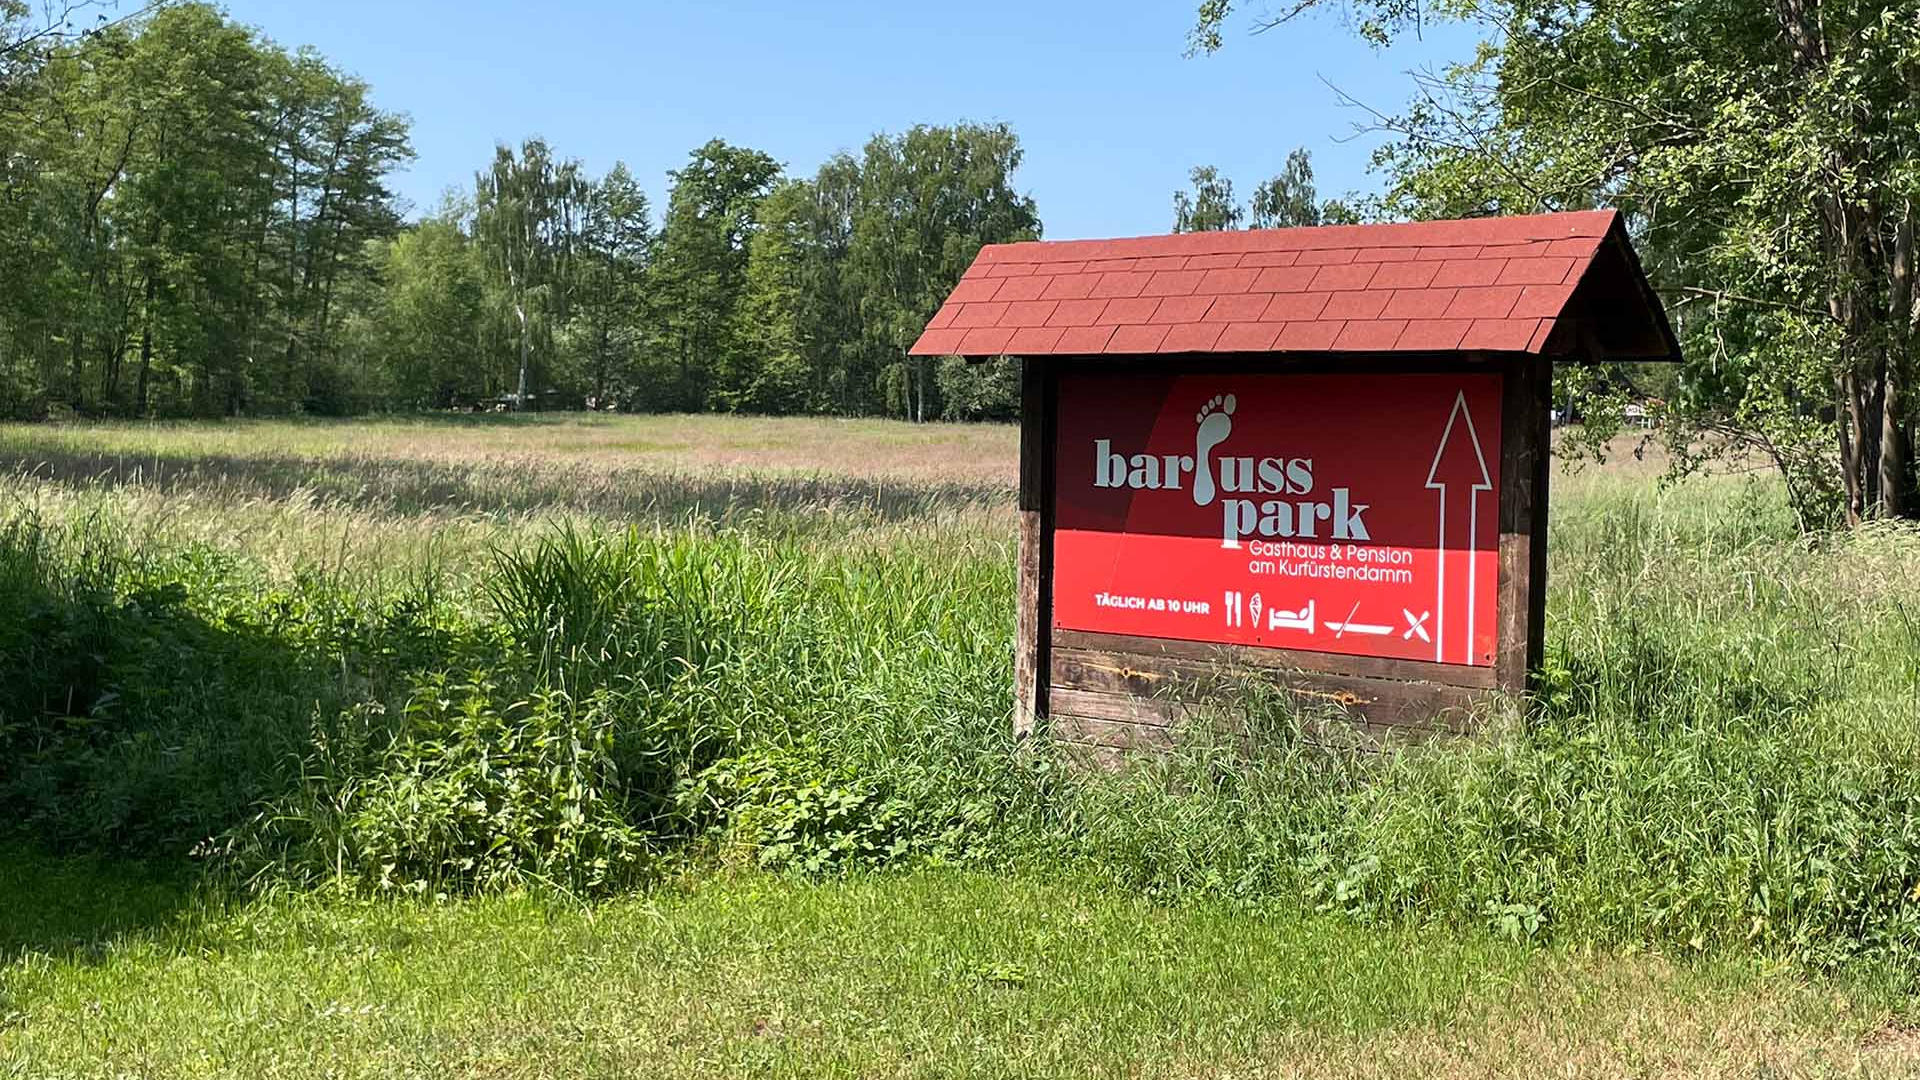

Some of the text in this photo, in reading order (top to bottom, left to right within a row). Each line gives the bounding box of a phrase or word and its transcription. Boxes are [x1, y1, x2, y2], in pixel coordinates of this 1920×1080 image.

[1093, 394, 1313, 506] barfuss
[1220, 487, 1371, 550] park
[1249, 539, 1413, 565] Gasthaus & Pension
[1249, 558, 1413, 584] am Kurfürstendamm
[1095, 592, 1210, 615] TÄGLICH AB 10 UHR
